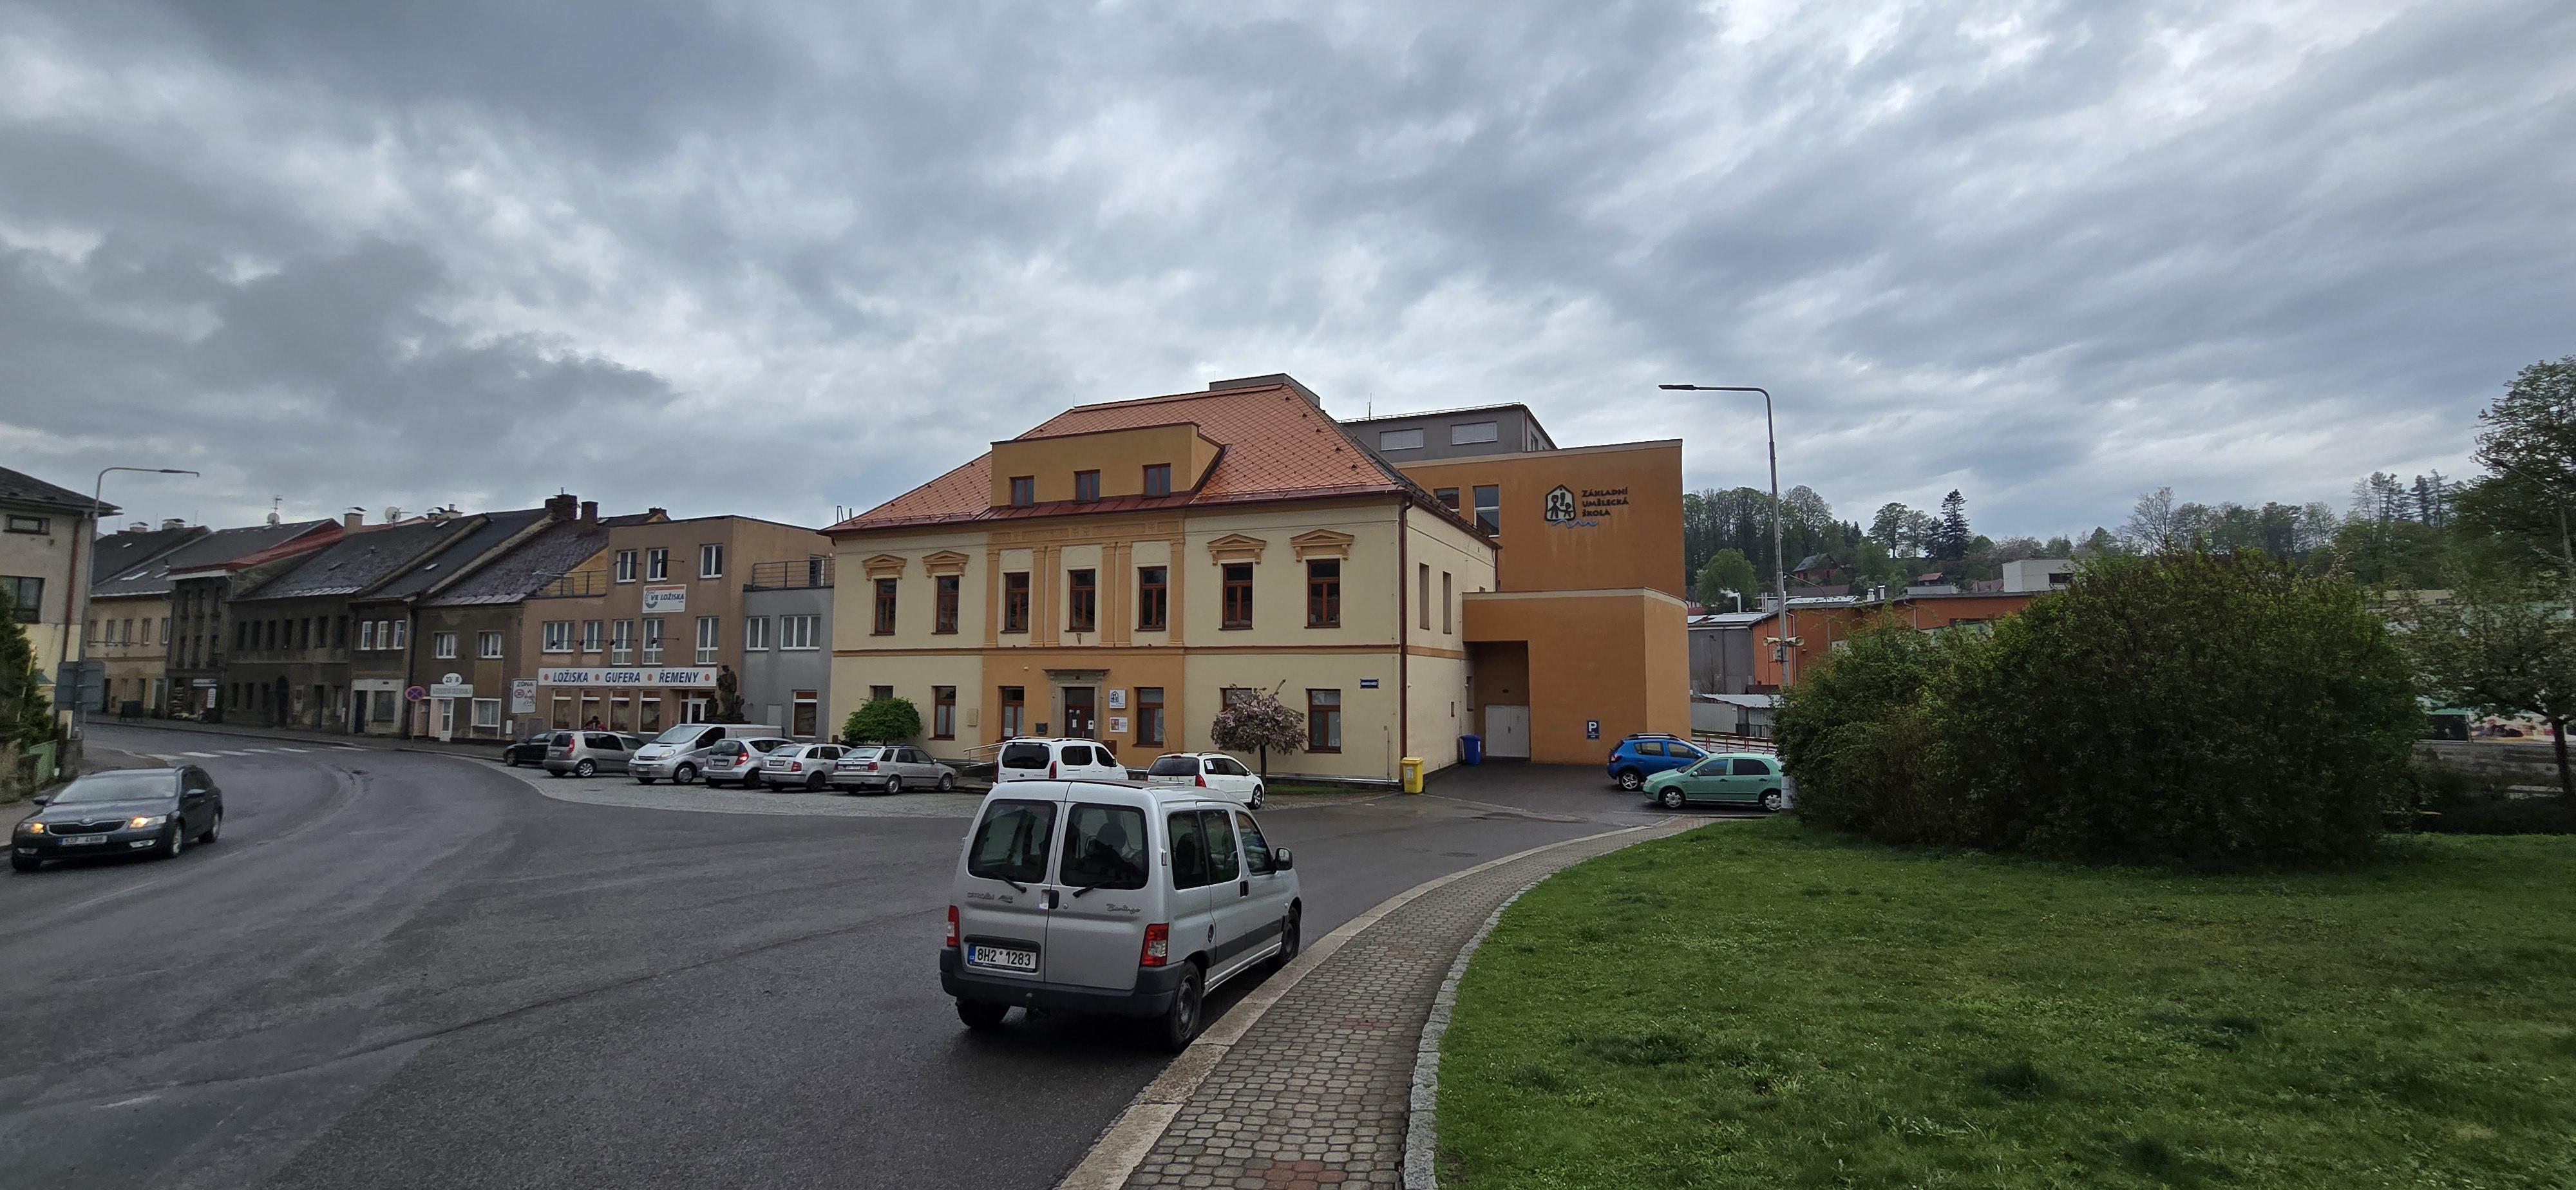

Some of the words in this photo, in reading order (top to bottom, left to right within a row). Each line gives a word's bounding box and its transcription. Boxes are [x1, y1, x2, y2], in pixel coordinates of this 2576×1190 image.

[1582, 486, 1629, 497] ZÁKLADNÍ
[1582, 496, 1629, 507] UMĚLECKÁ
[1582, 509, 1611, 517] ŠKOLA
[553, 670, 589, 683] LOŽISKA
[605, 672, 640, 683] GUFERA
[658, 670, 699, 683] ŘEMENY
[1588, 721, 1597, 732] P
[977, 948, 997, 962] 8H2
[1005, 951, 1031, 966] 1283
